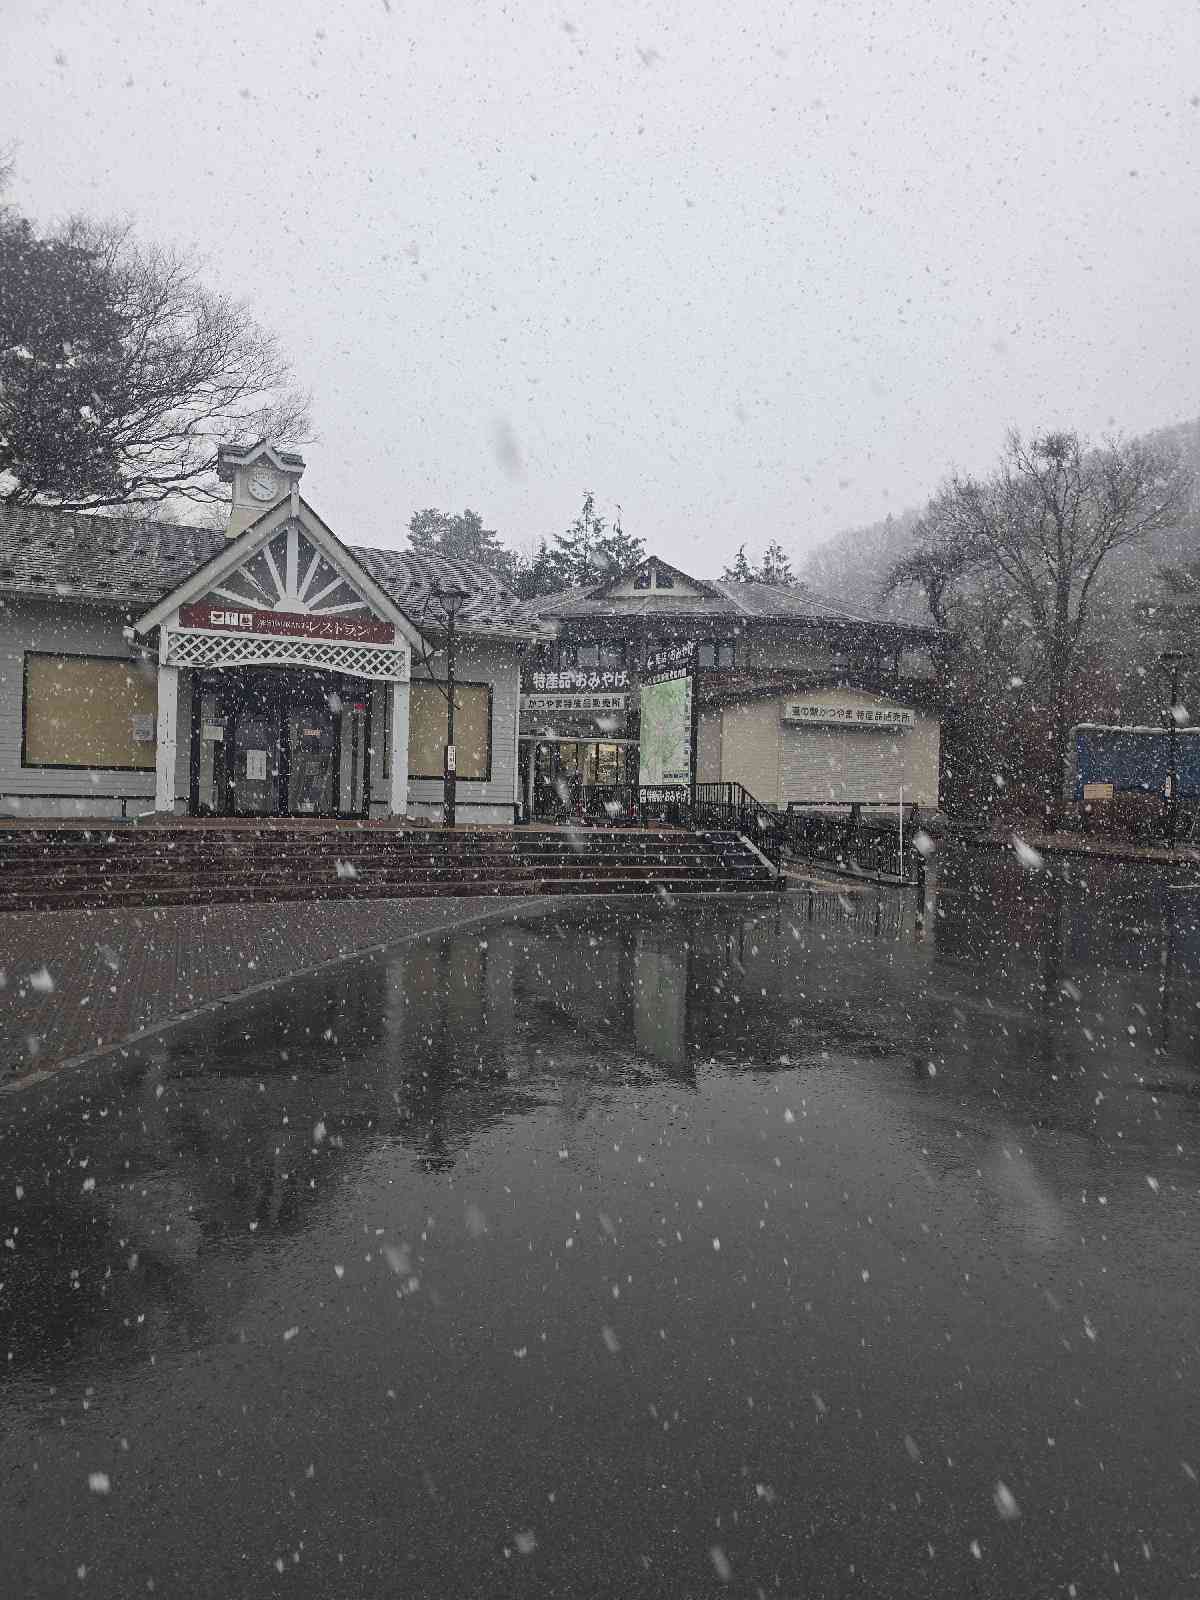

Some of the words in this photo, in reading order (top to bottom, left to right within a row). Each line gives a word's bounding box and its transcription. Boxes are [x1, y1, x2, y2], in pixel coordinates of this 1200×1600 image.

[308, 621, 369, 636] レストラン
